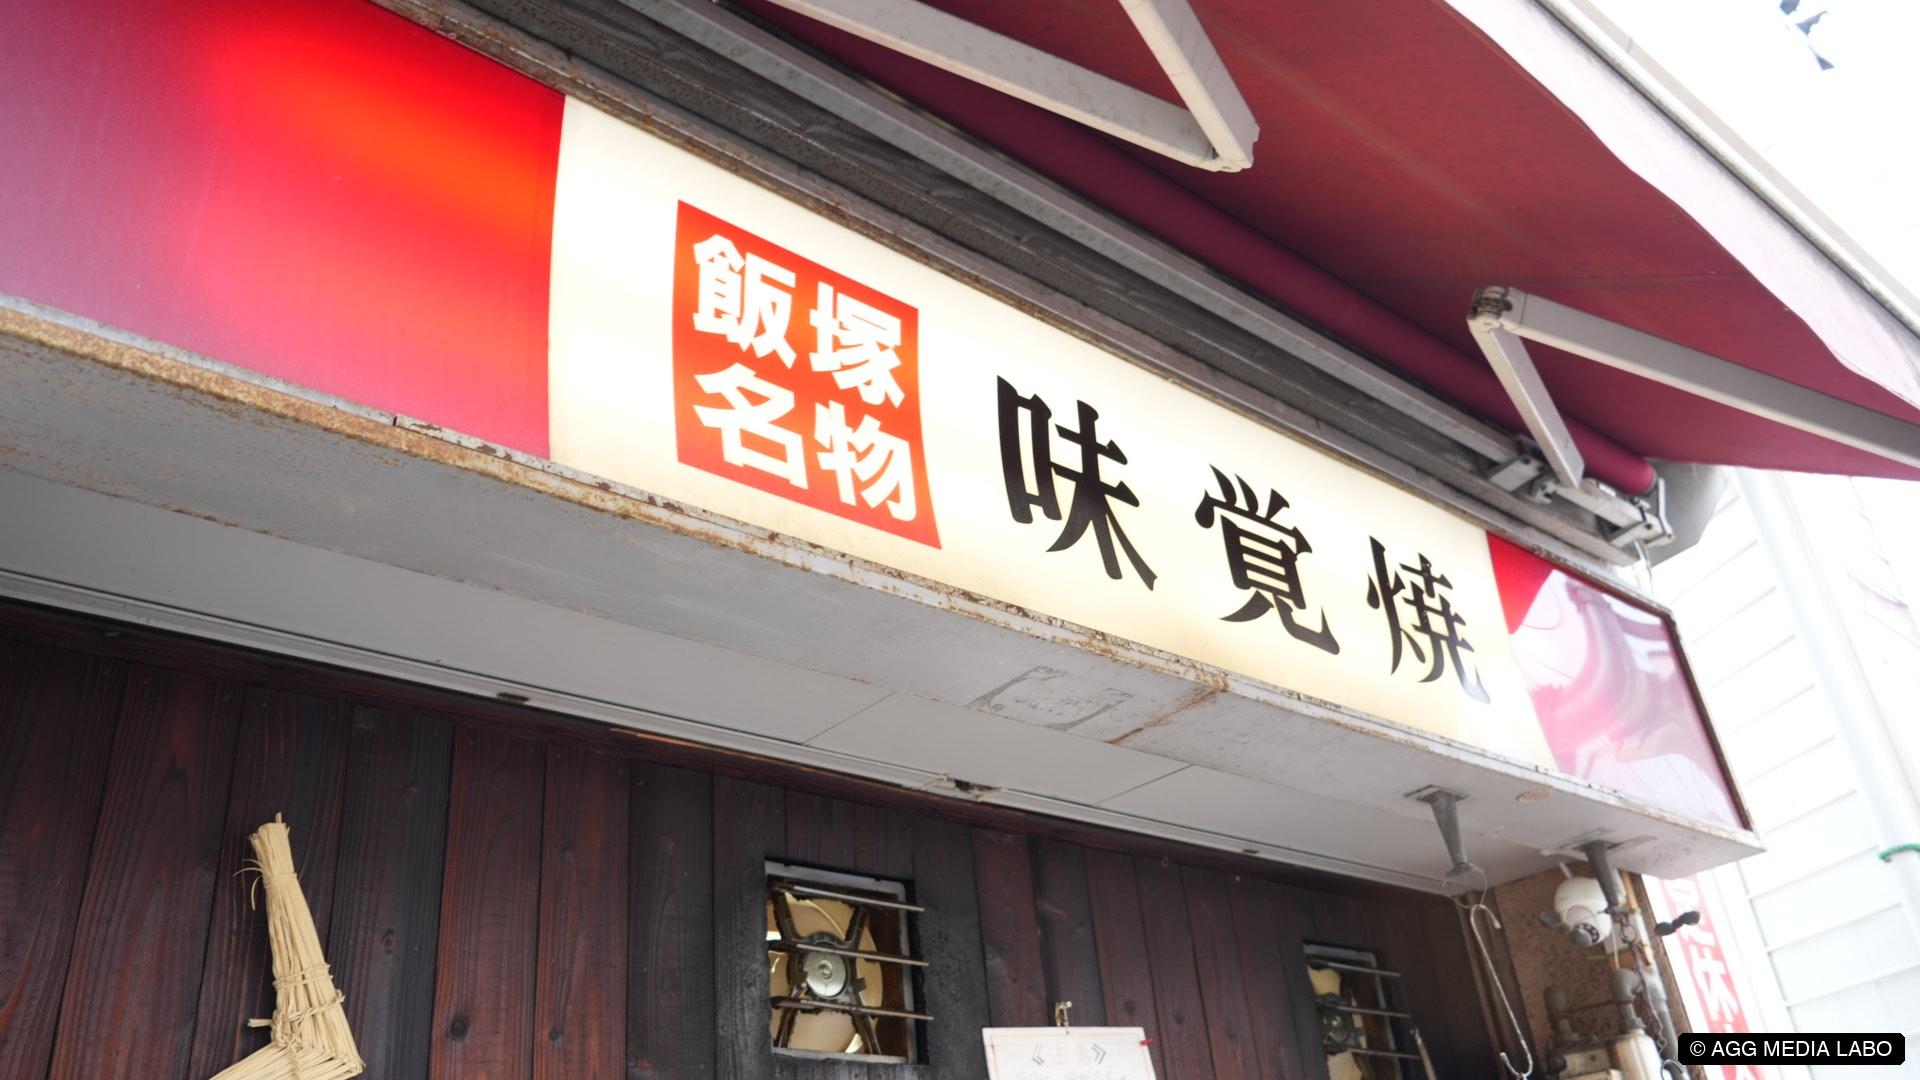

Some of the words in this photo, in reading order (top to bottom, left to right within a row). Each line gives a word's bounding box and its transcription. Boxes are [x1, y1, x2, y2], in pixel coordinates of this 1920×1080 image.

[692, 233, 905, 409] 飯塚
[691, 361, 917, 522] 名物
[996, 374, 1491, 704] 味覚焼
